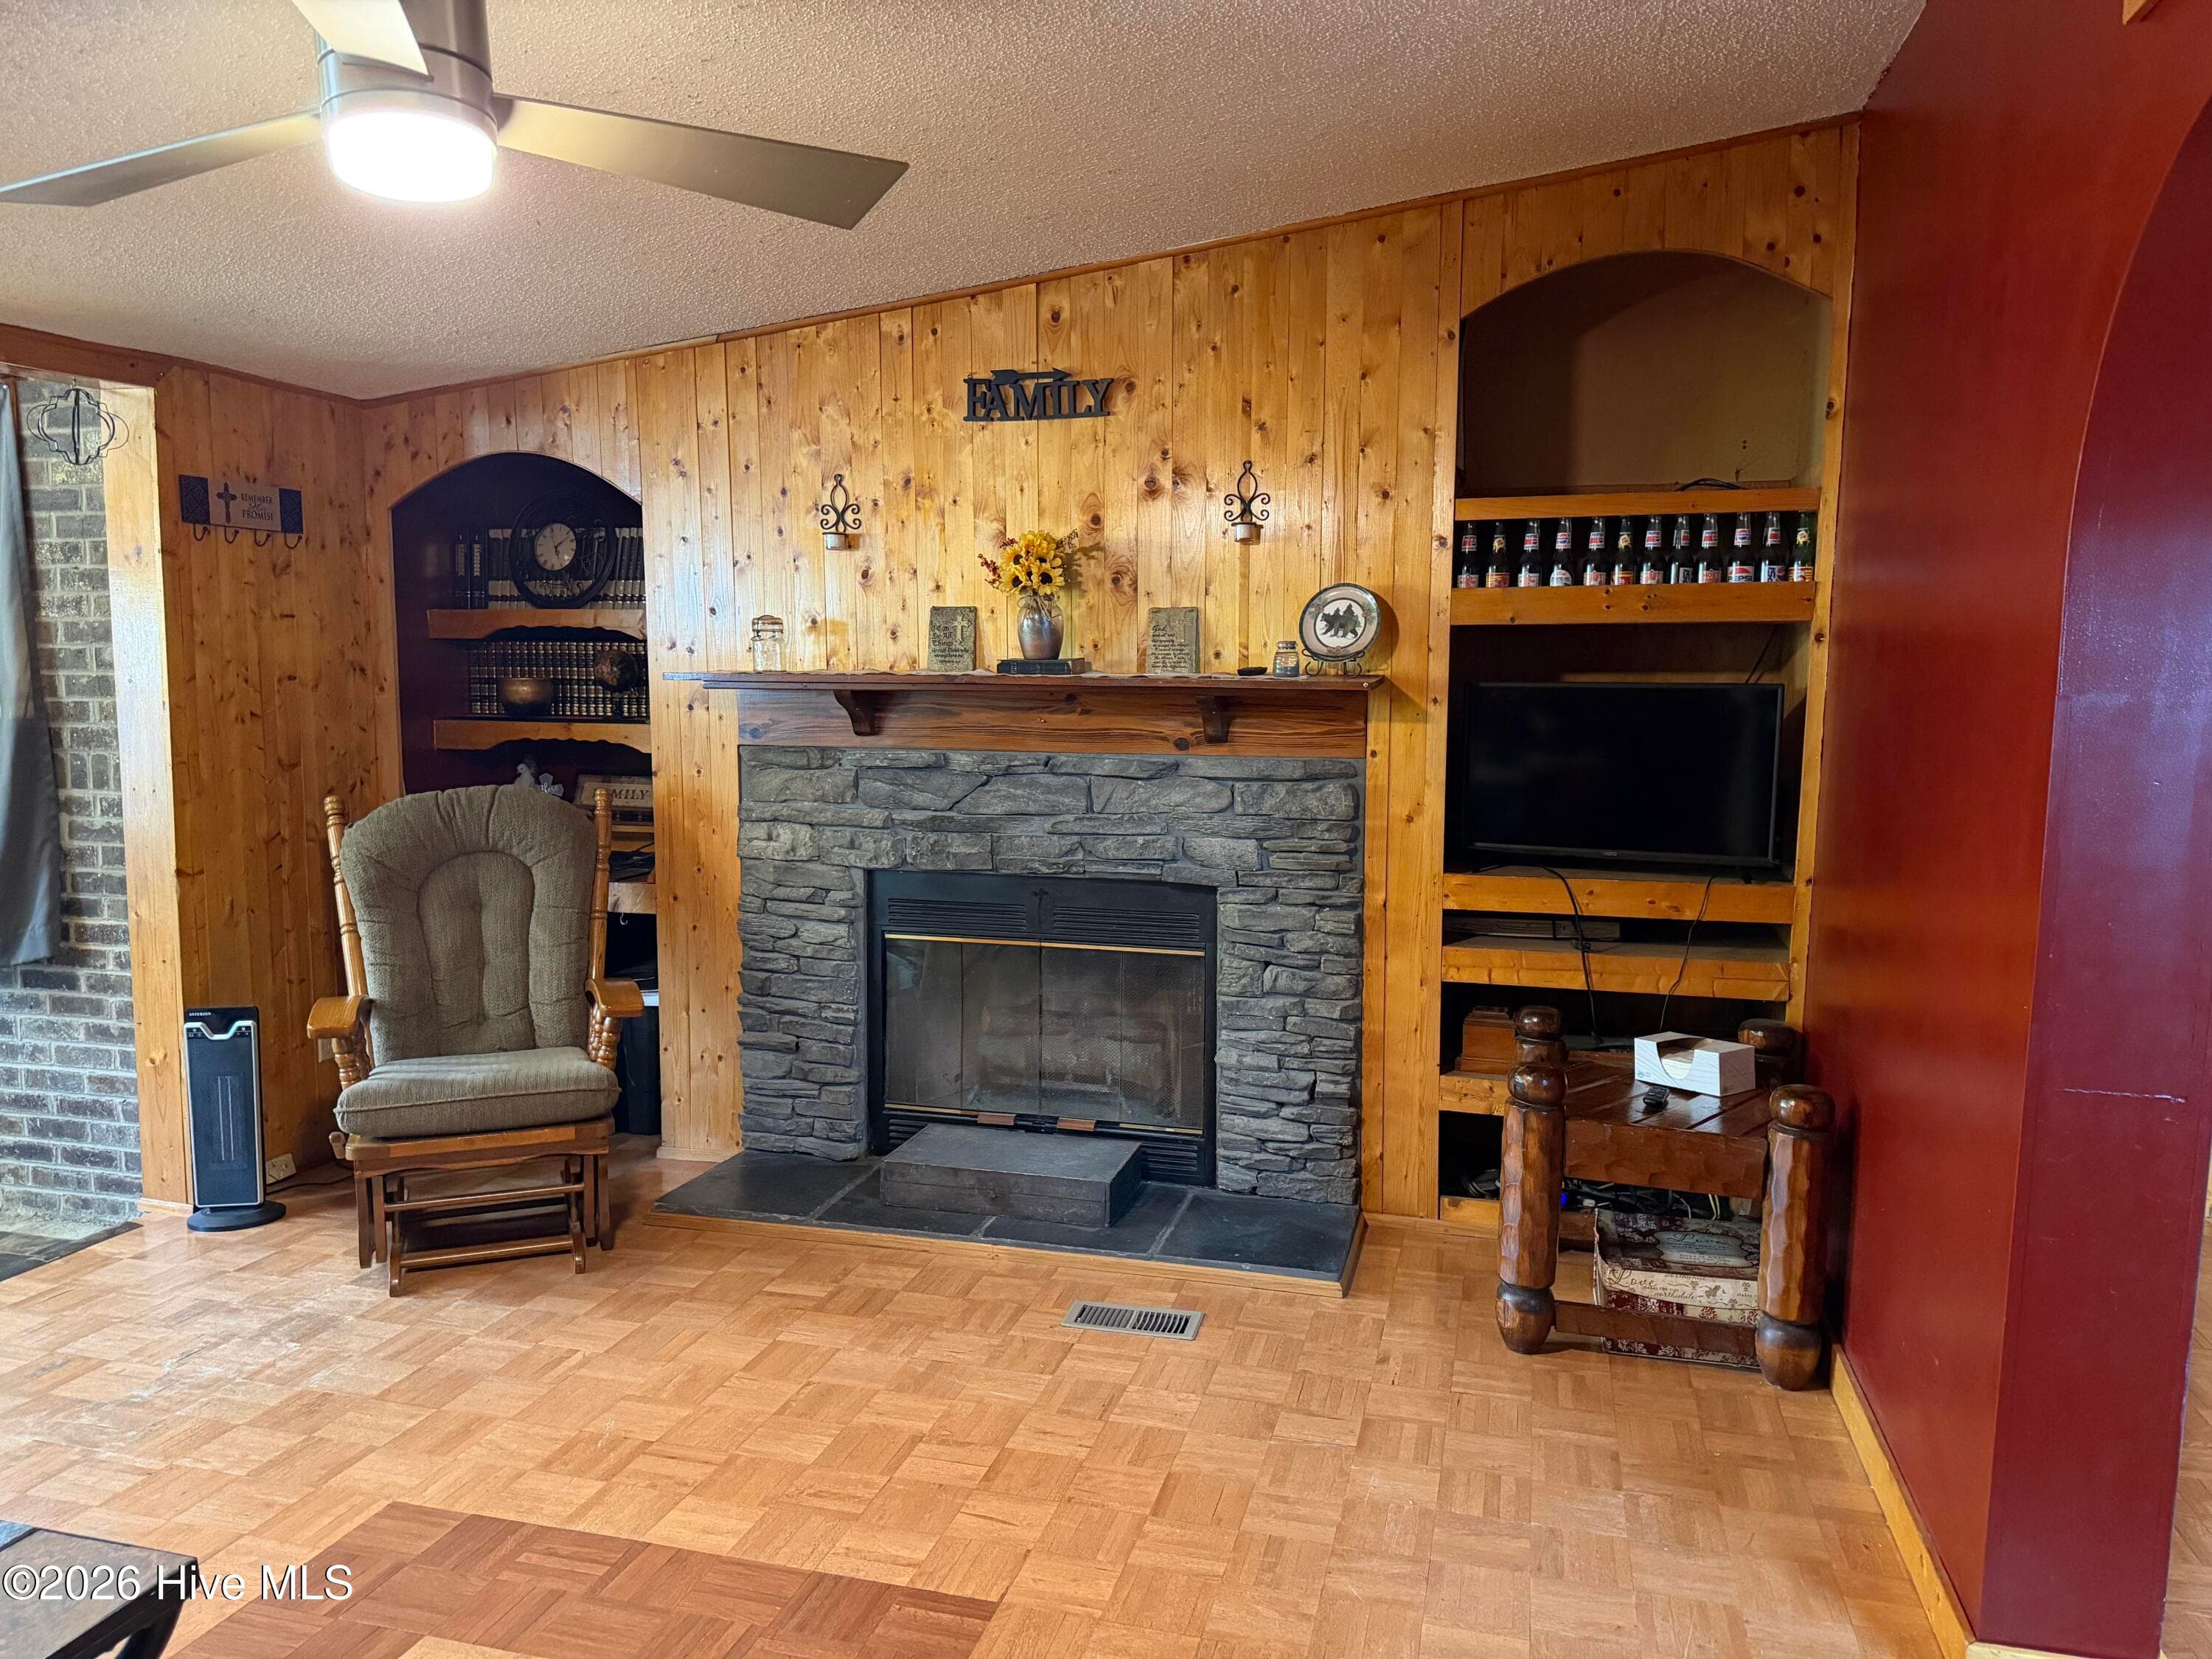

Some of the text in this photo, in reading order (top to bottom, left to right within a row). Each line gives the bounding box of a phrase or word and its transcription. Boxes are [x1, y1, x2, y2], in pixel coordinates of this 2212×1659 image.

[963, 378, 1114, 422] FAMILY
[240, 493, 273, 504] REMEMBER
[242, 509, 273, 521] PROMISE
[932, 639, 954, 647] Things
[1607, 1267, 1658, 1288] Love
